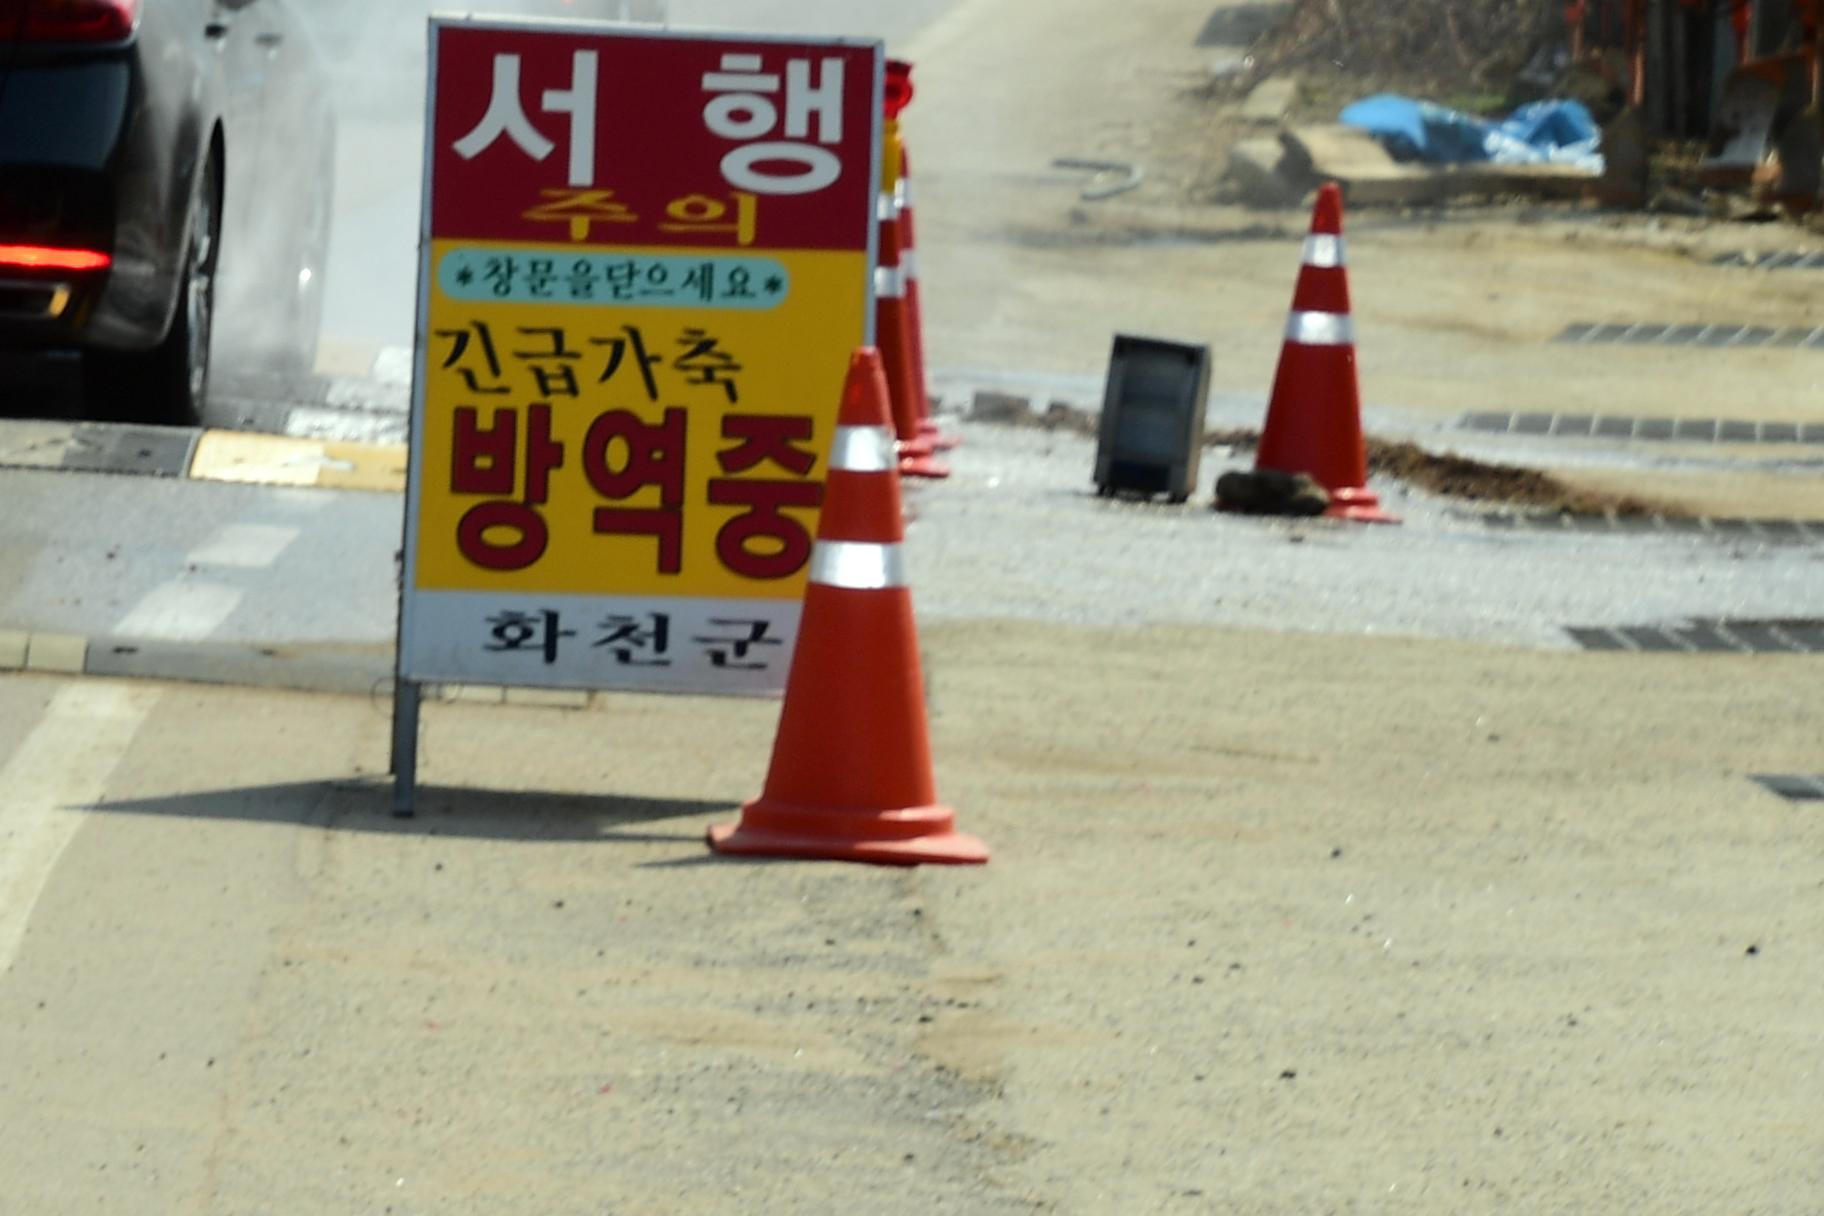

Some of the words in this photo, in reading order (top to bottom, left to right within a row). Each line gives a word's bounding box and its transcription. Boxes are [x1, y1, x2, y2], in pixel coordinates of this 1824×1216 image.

[435, 320, 743, 404] 긴급가축
[451, 404, 825, 580] 방역중
[483, 609, 783, 670] 화천군
